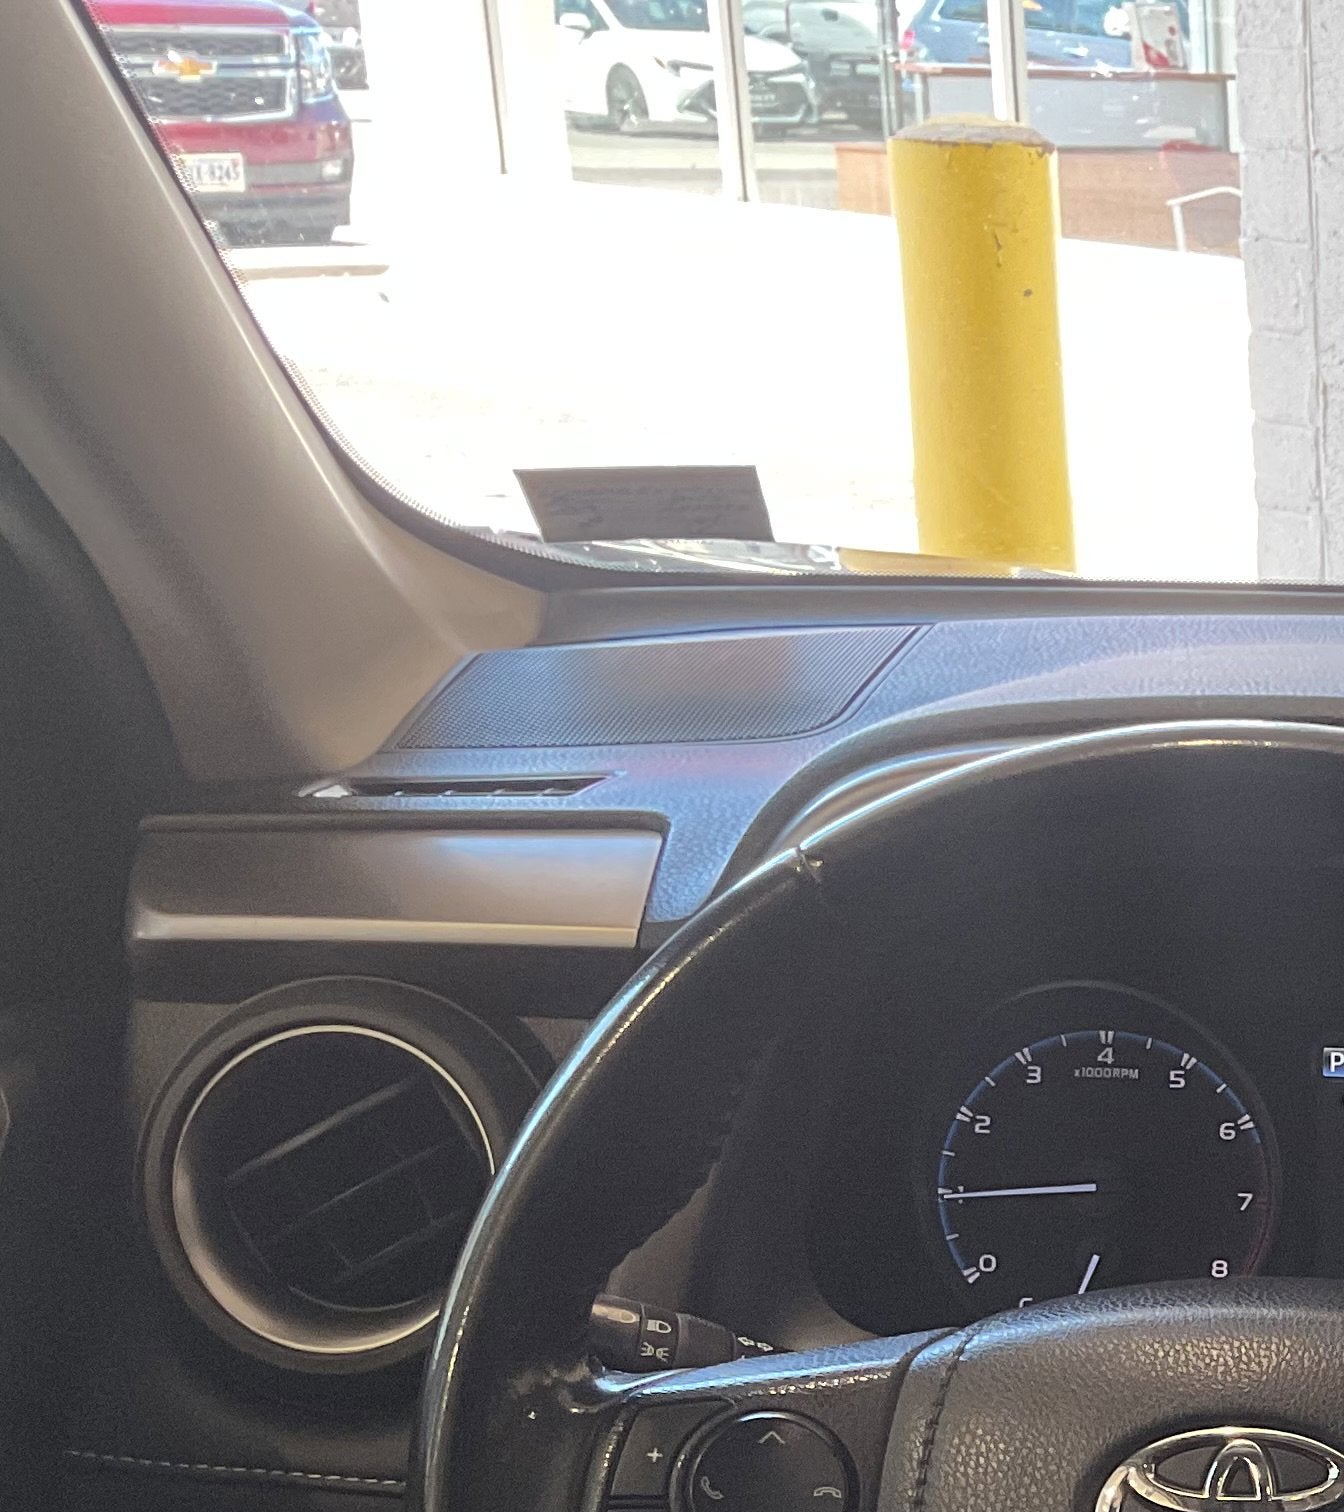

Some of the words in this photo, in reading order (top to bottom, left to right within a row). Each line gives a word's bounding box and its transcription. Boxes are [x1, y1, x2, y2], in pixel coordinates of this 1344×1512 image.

[1097, 1047, 1114, 1064] 4
[1026, 1066, 1042, 1084] 3
[1169, 1070, 1186, 1089] 5
[975, 1115, 991, 1133] 2
[1219, 1123, 1236, 1141] 6
[1238, 1193, 1254, 1211] 7
[979, 1255, 997, 1273] 0
[1212, 1261, 1228, 1278] 8
